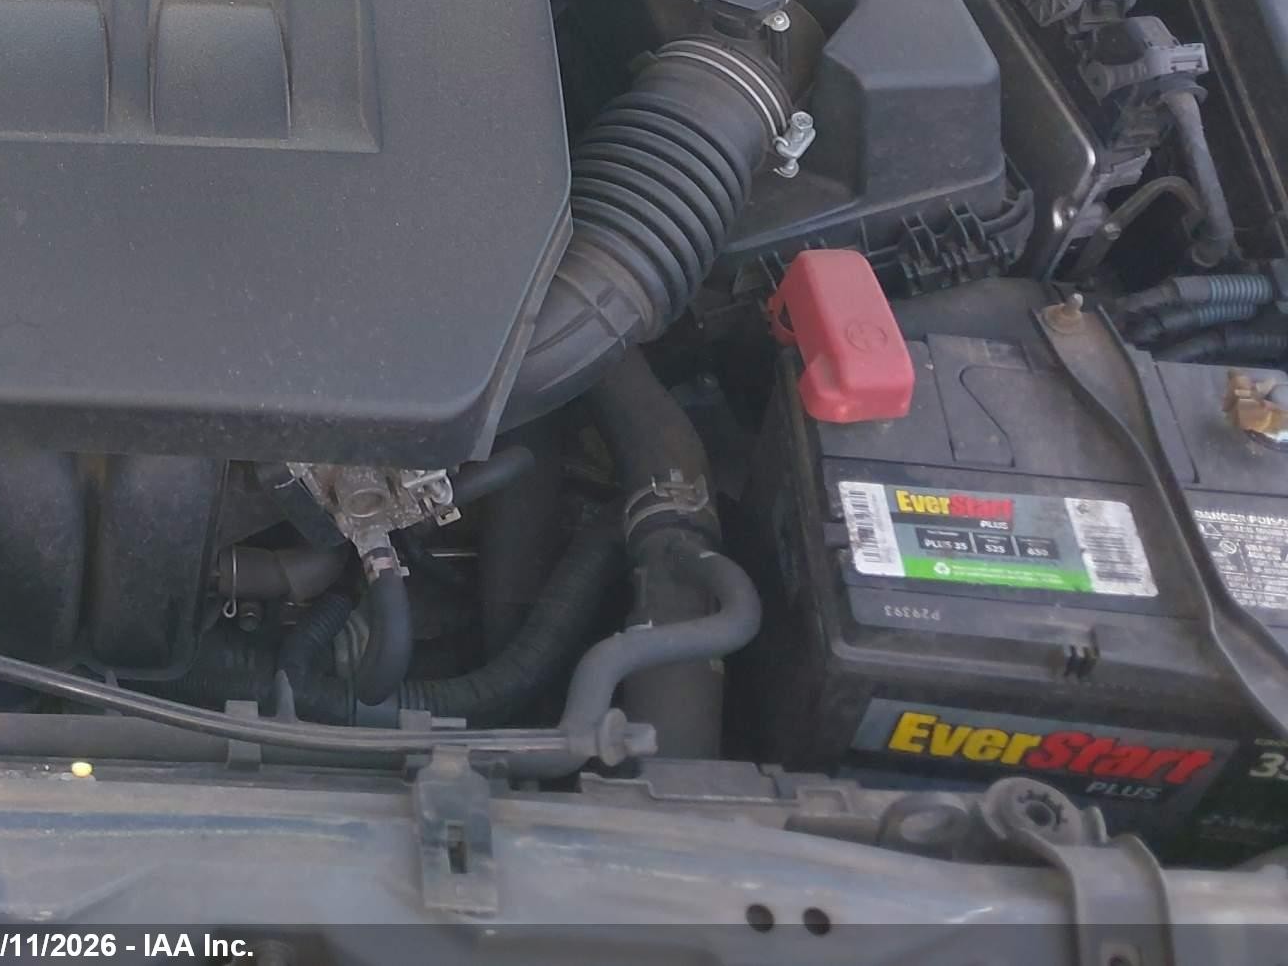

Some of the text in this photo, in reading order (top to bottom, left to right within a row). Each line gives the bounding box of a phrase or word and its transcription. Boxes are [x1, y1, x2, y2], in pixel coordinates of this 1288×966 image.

[895, 489, 1013, 520] EverStart
[979, 520, 1009, 530] PLUS
[888, 711, 1213, 785] EverStart
[1249, 752, 1288, 781] 3
[1085, 779, 1164, 802] PLUS
